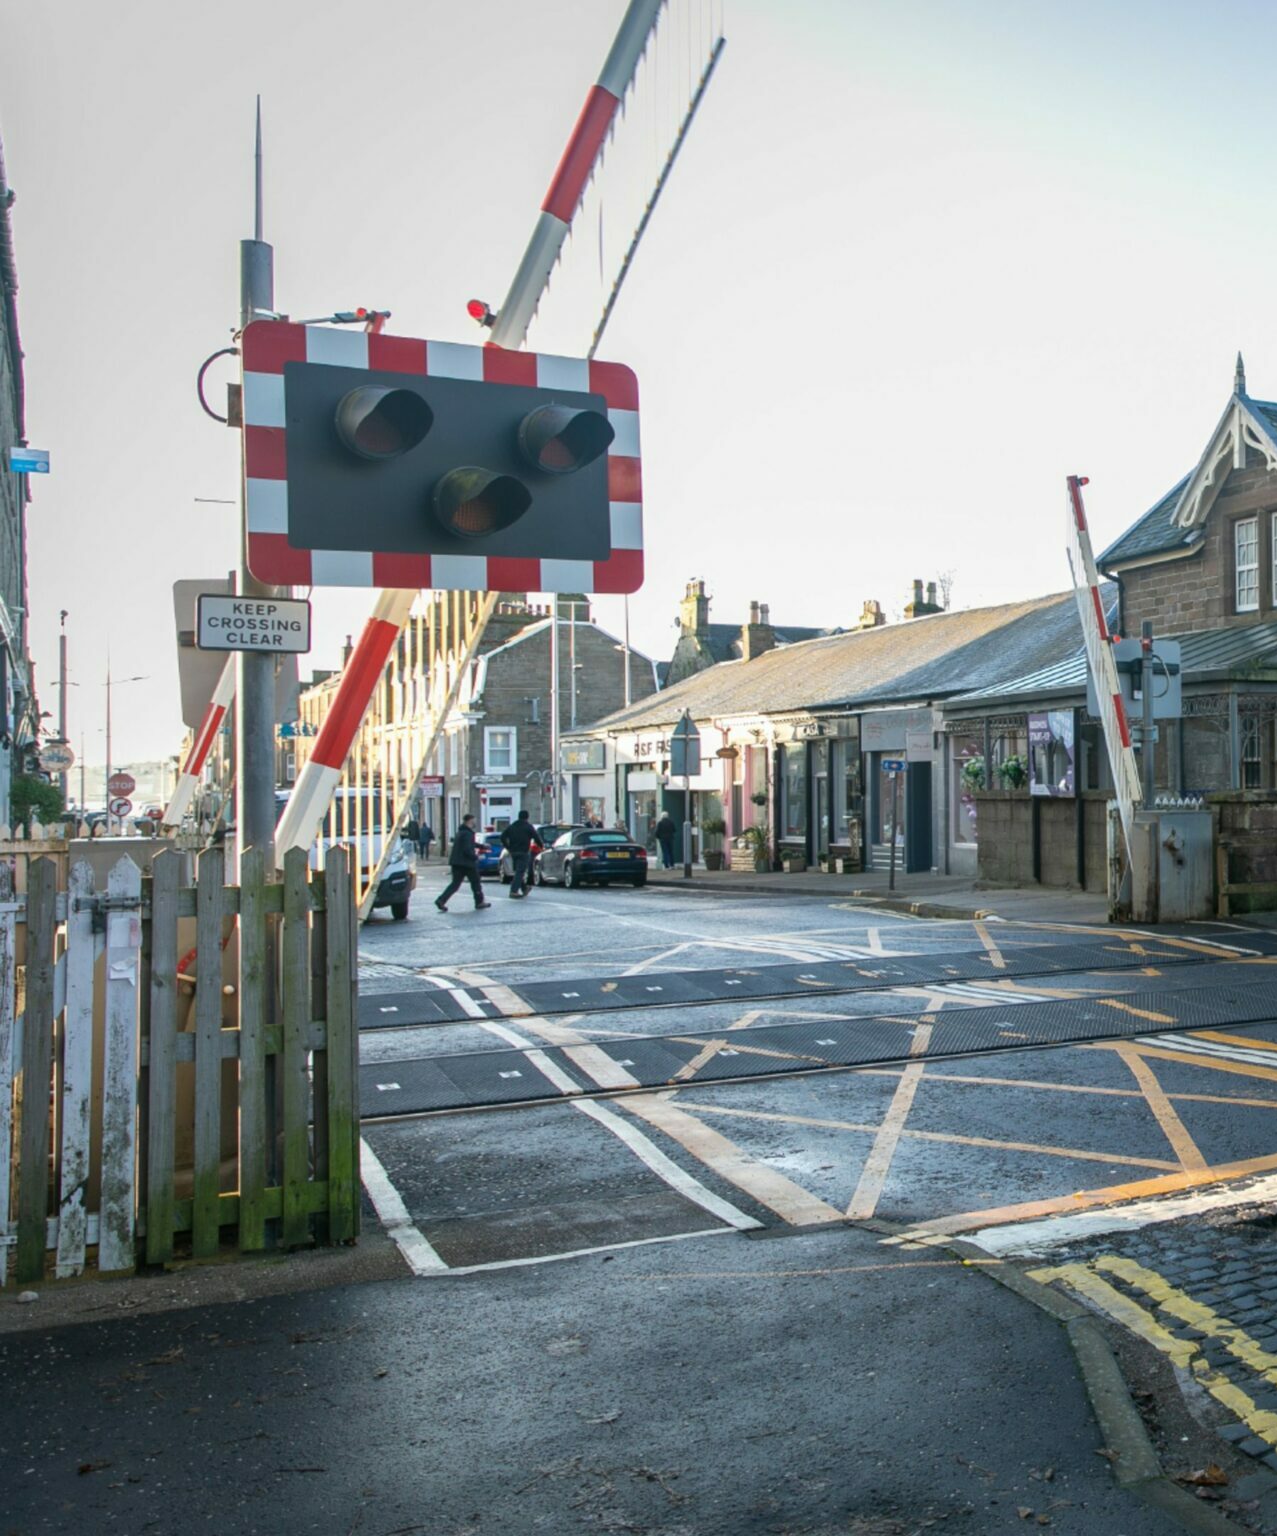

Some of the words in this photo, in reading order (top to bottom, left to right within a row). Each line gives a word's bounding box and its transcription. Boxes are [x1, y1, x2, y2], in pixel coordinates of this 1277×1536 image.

[233, 603, 277, 616] KEEP
[207, 616, 302, 632] CROSSING
[226, 632, 283, 646] CLEAR
[109, 782, 133, 790] STOP
